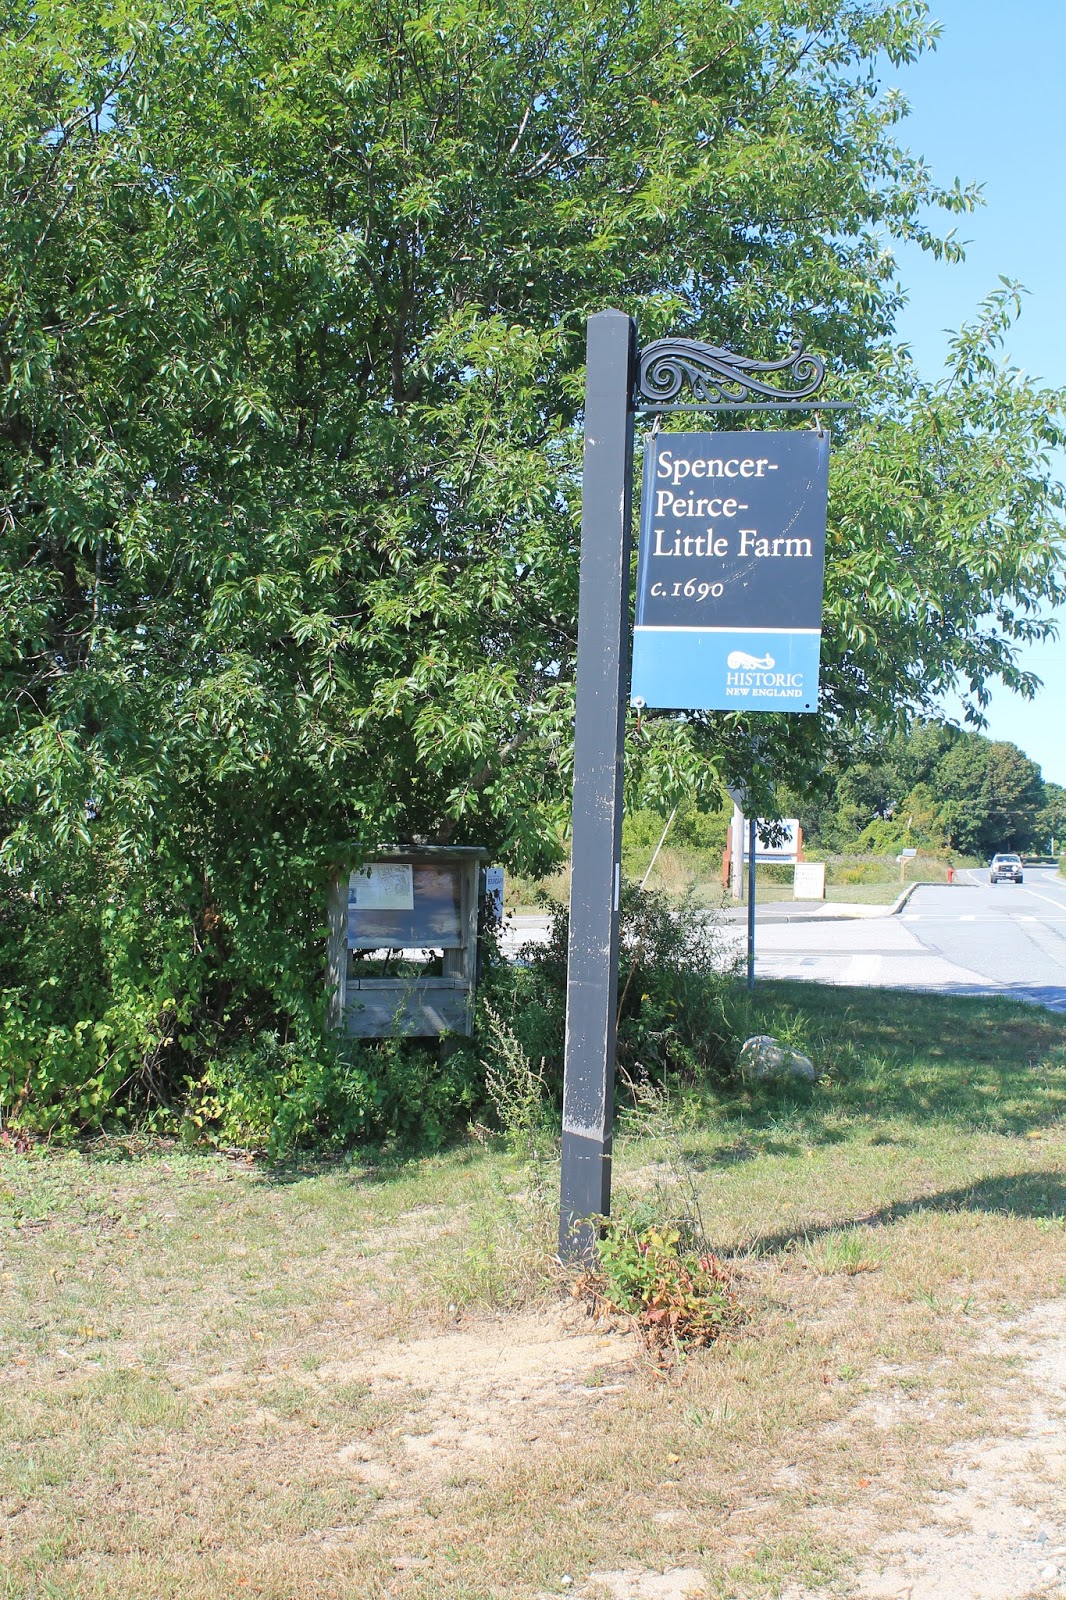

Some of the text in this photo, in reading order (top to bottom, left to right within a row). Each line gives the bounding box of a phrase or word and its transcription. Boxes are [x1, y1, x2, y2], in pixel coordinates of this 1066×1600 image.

[656, 451, 779, 485] Spencer-
[654, 490, 749, 517] Peirce-
[652, 529, 812, 557] Little Farm
[726, 688, 802, 698] NEW ENGLAND
[727, 672, 803, 687] HISTORIC
